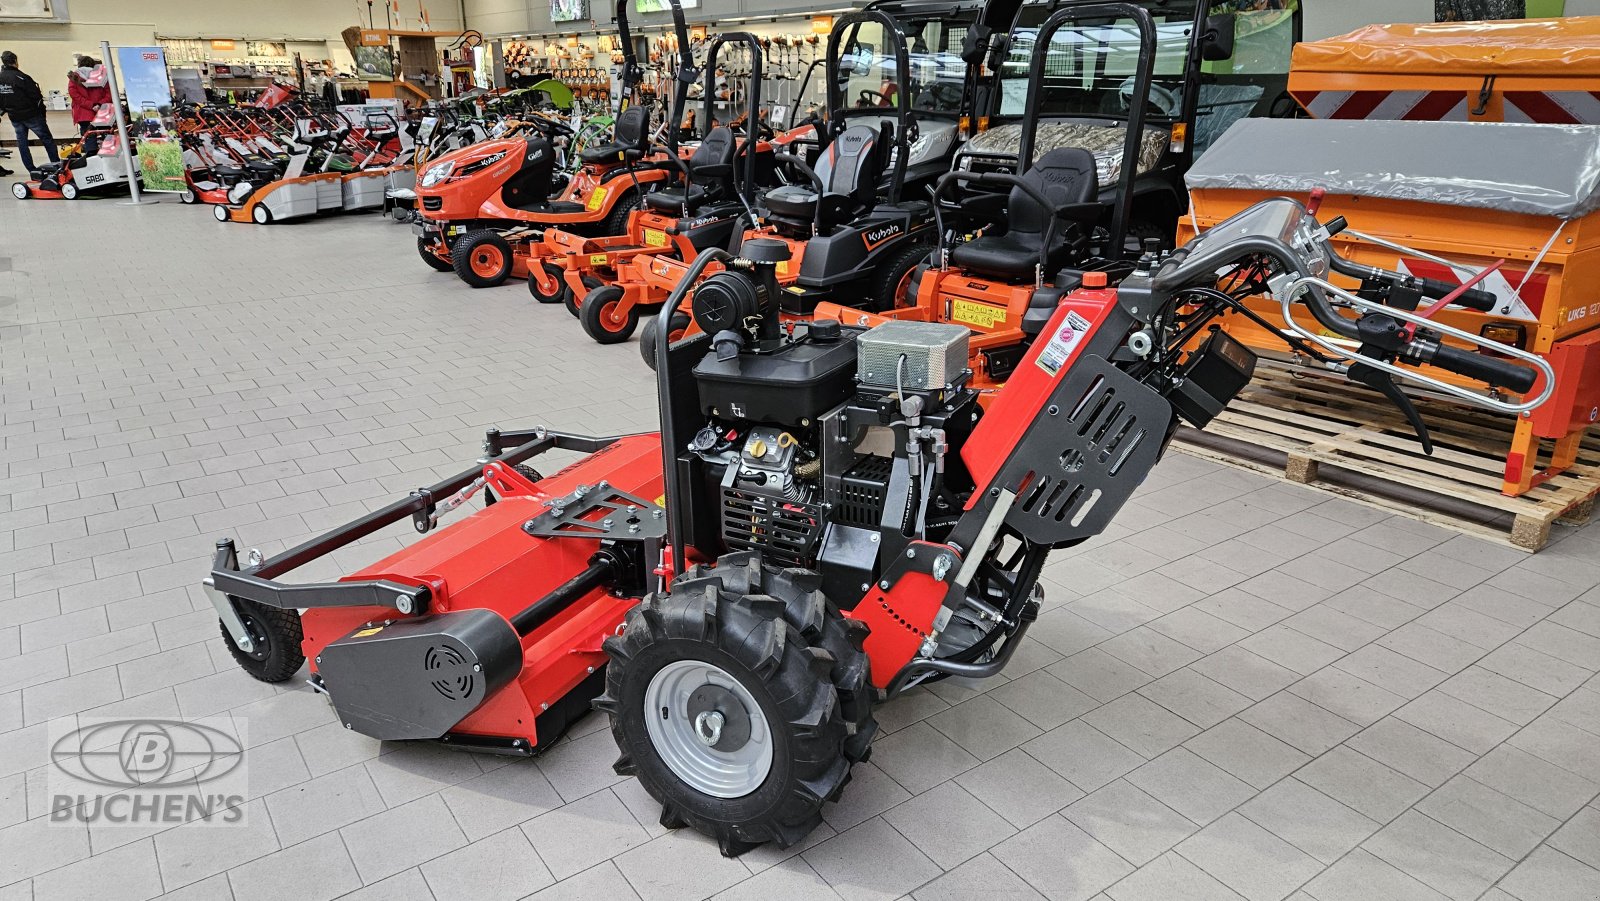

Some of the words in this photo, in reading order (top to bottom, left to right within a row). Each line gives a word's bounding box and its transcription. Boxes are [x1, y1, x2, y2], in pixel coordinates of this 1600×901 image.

[846, 135, 862, 143] Kubota
[480, 152, 505, 166] Kubota
[85, 173, 105, 185] SABO
[695, 215, 719, 225] Kubota
[868, 224, 899, 241] Kubota
[1567, 306, 1587, 323] UKS
